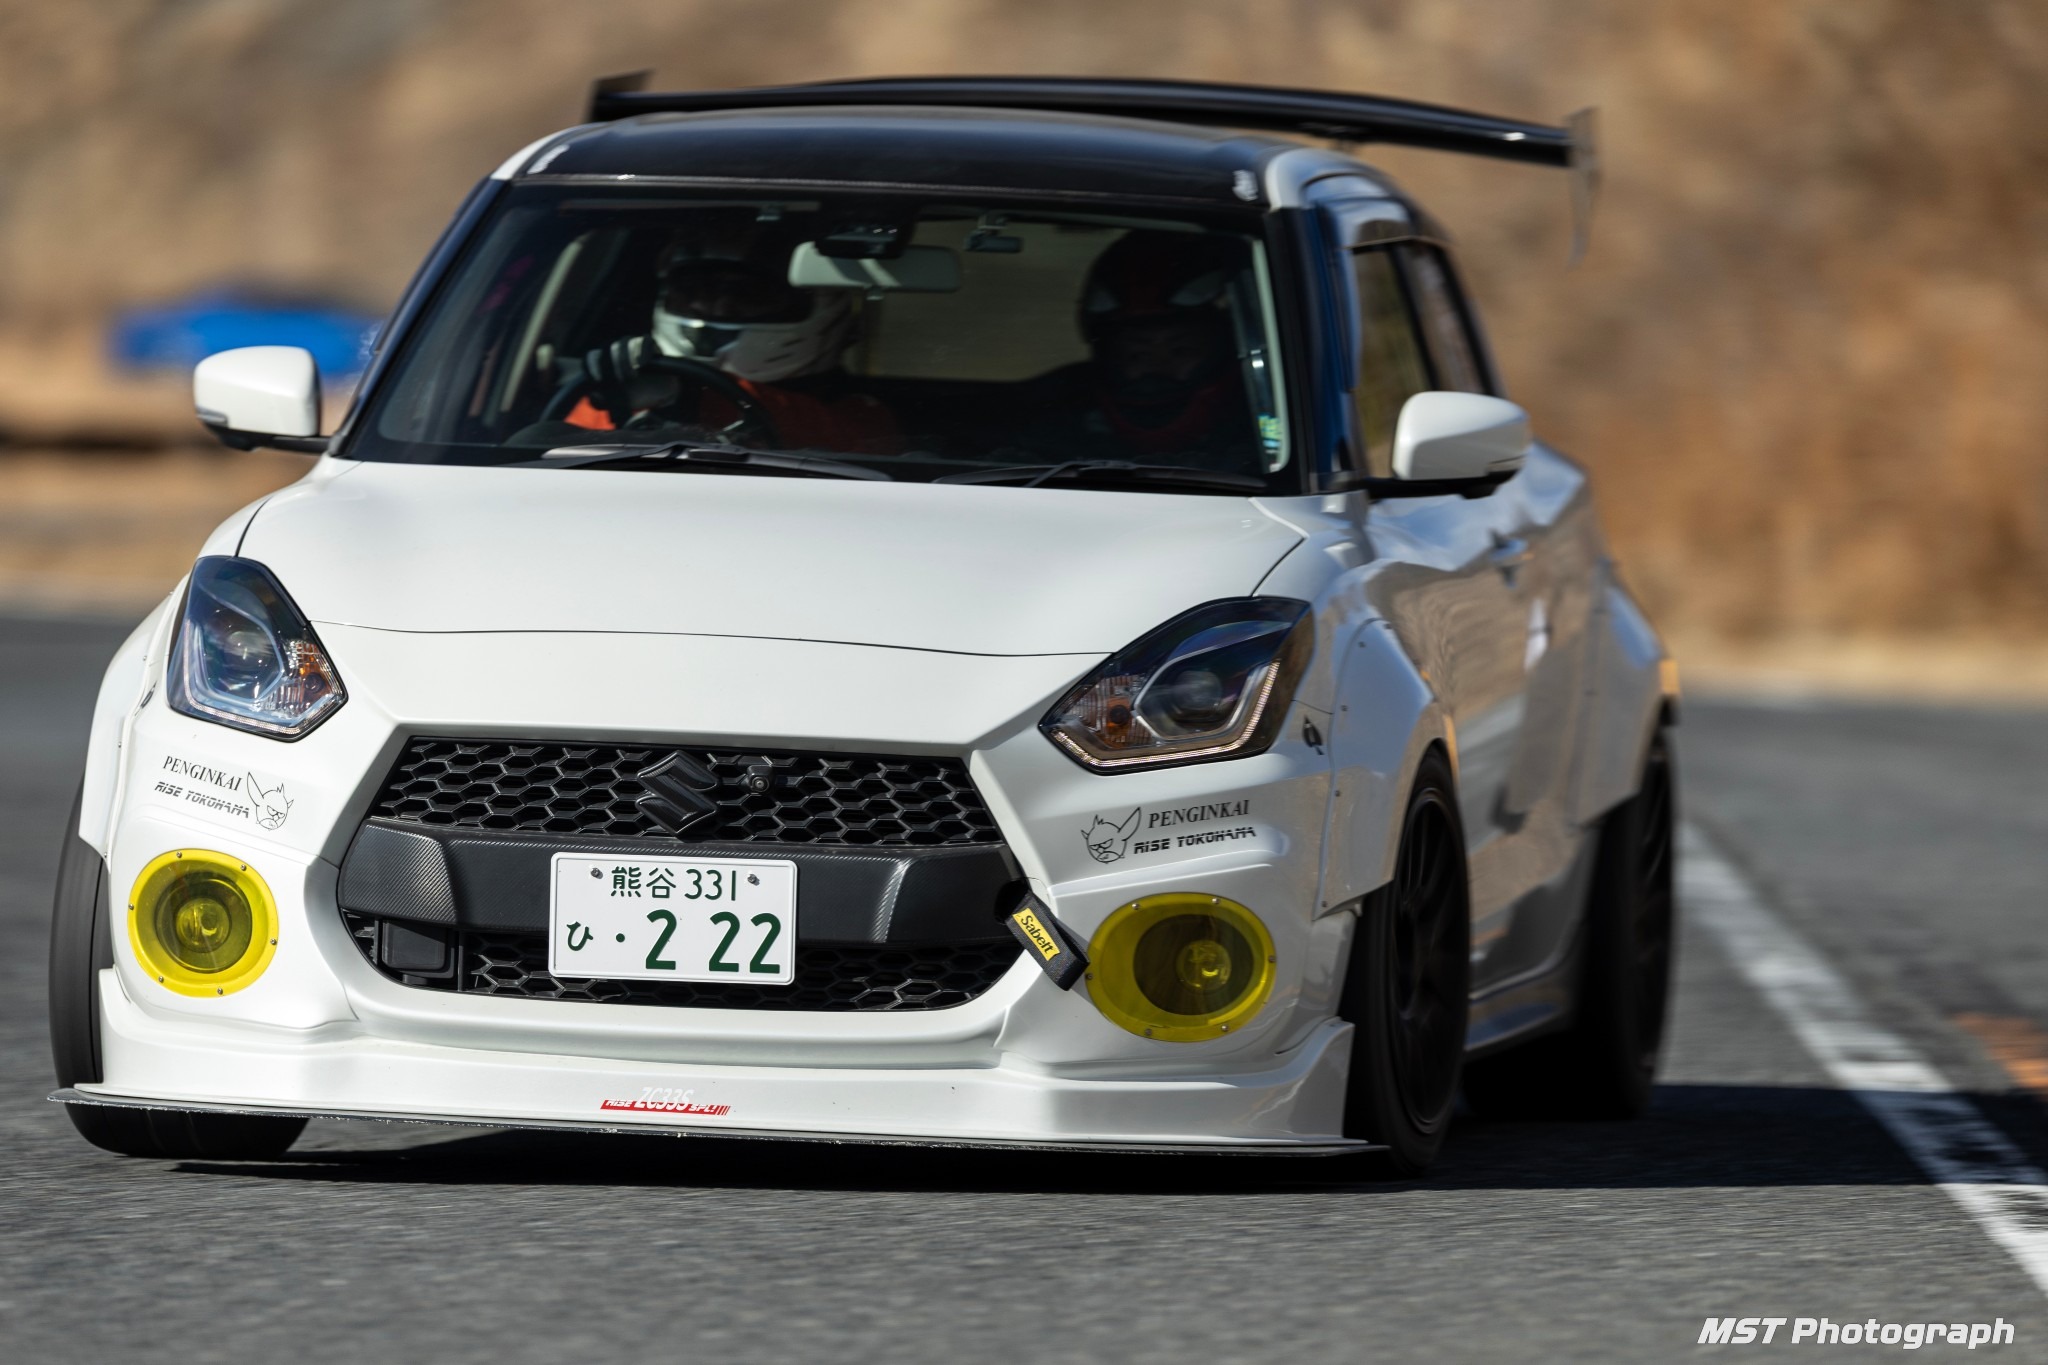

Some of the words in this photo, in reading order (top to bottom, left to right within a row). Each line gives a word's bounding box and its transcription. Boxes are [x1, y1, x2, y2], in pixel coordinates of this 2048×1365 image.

[163, 755, 242, 791] PENGINKAI
[1148, 799, 1250, 829] PENGINKAI
[610, 866, 677, 899] 熊谷
[684, 868, 737, 901] 331
[566, 921, 594, 952] ひ
[1020, 914, 1054, 954] Sabelt
